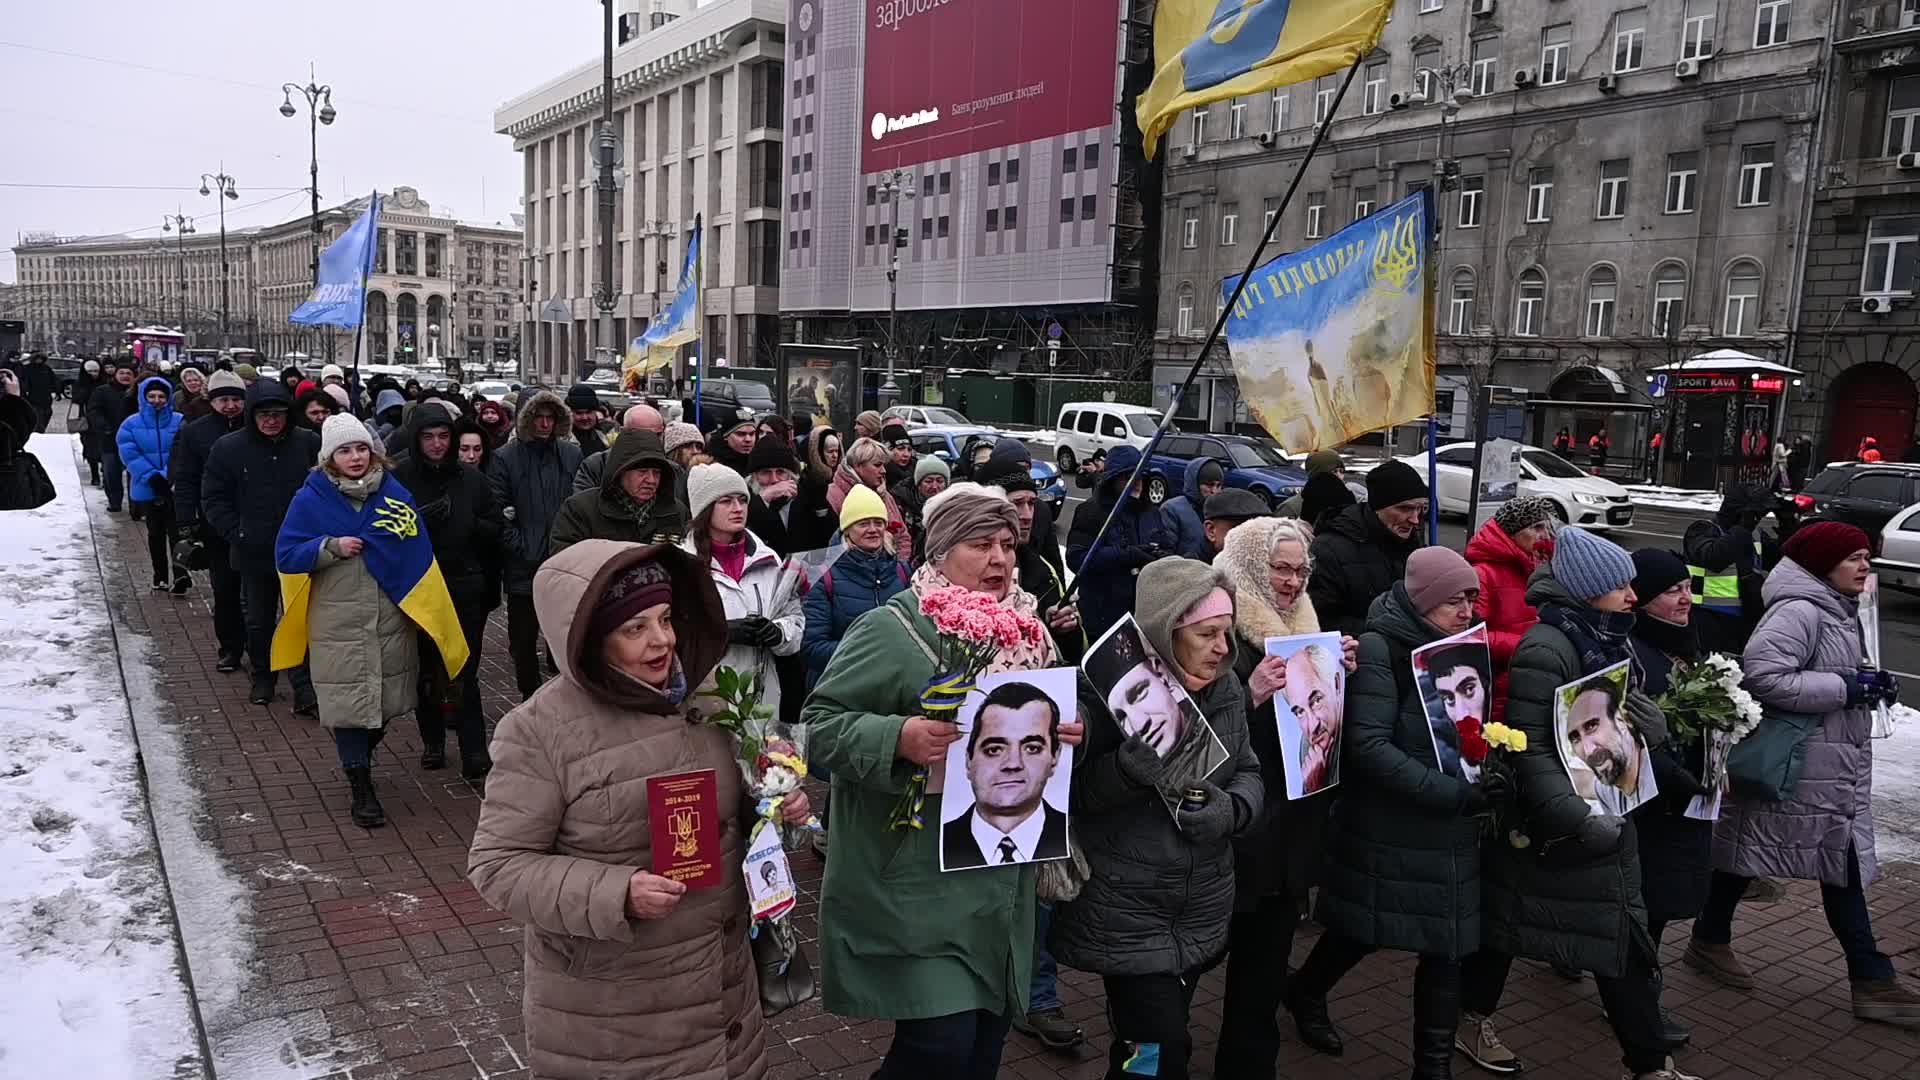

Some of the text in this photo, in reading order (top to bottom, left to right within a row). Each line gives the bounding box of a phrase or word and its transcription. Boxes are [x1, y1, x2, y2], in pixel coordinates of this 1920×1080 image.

[951, 103, 972, 116] Банк
[971, 90, 1014, 115] розумних
[1678, 378, 1737, 387] SPORT KAVA
